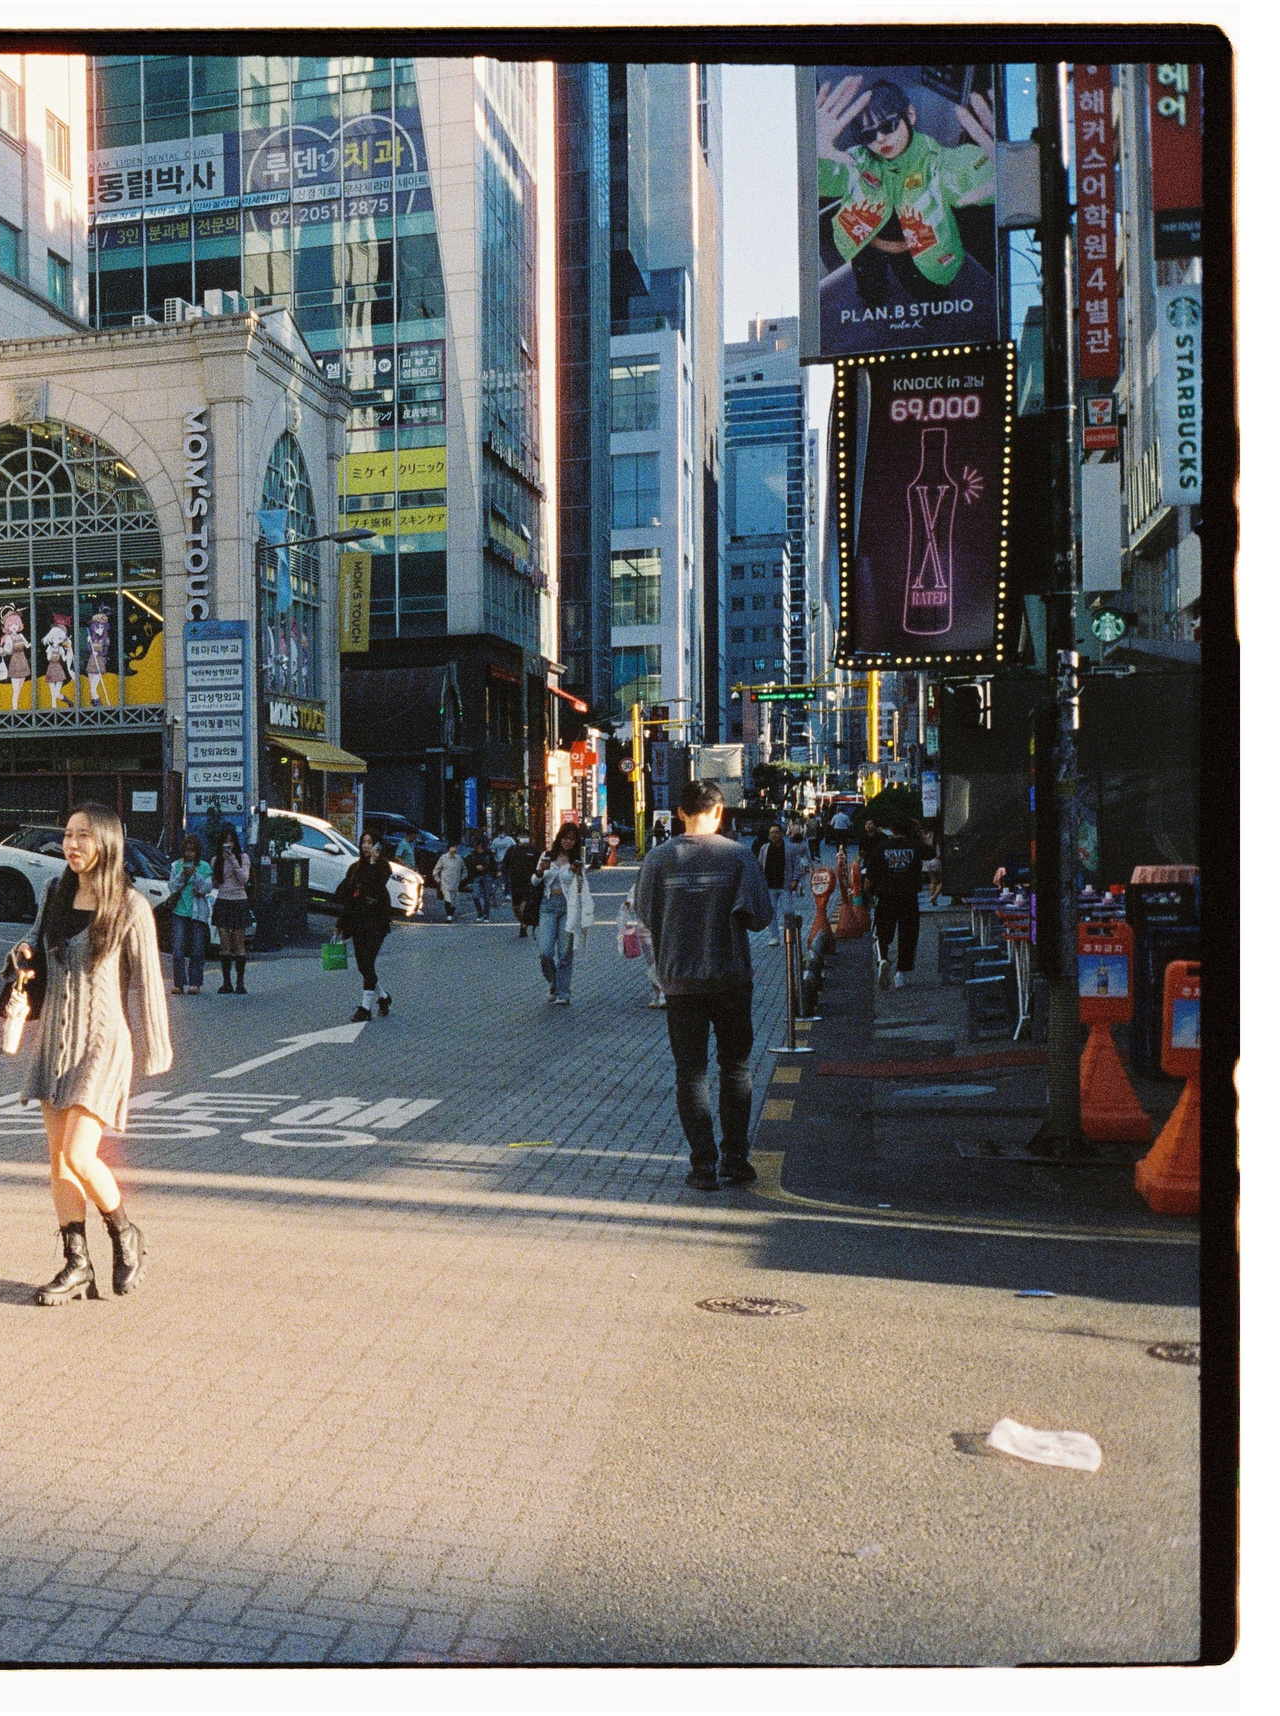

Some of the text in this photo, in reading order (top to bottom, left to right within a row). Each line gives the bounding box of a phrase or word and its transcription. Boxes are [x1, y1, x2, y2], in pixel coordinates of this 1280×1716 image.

[343, 135, 405, 172] 치과
[197, 214, 240, 236] 전문의
[840, 298, 974, 325] PLAN.B STUDIO
[893, 376, 944, 392] KNOCK
[946, 375, 960, 389] in
[890, 394, 982, 422] 69.000
[1175, 333, 1198, 490] STARBUCKS
[398, 460, 446, 476] クリニック
[182, 406, 211, 622] MOM'S TOUC
[399, 512, 446, 526] スキンケア
[911, 591, 948, 606] RATED
[351, 603, 362, 644] TOUCH
[269, 701, 299, 729] MOM'S
[622, 761, 634, 770] 30
